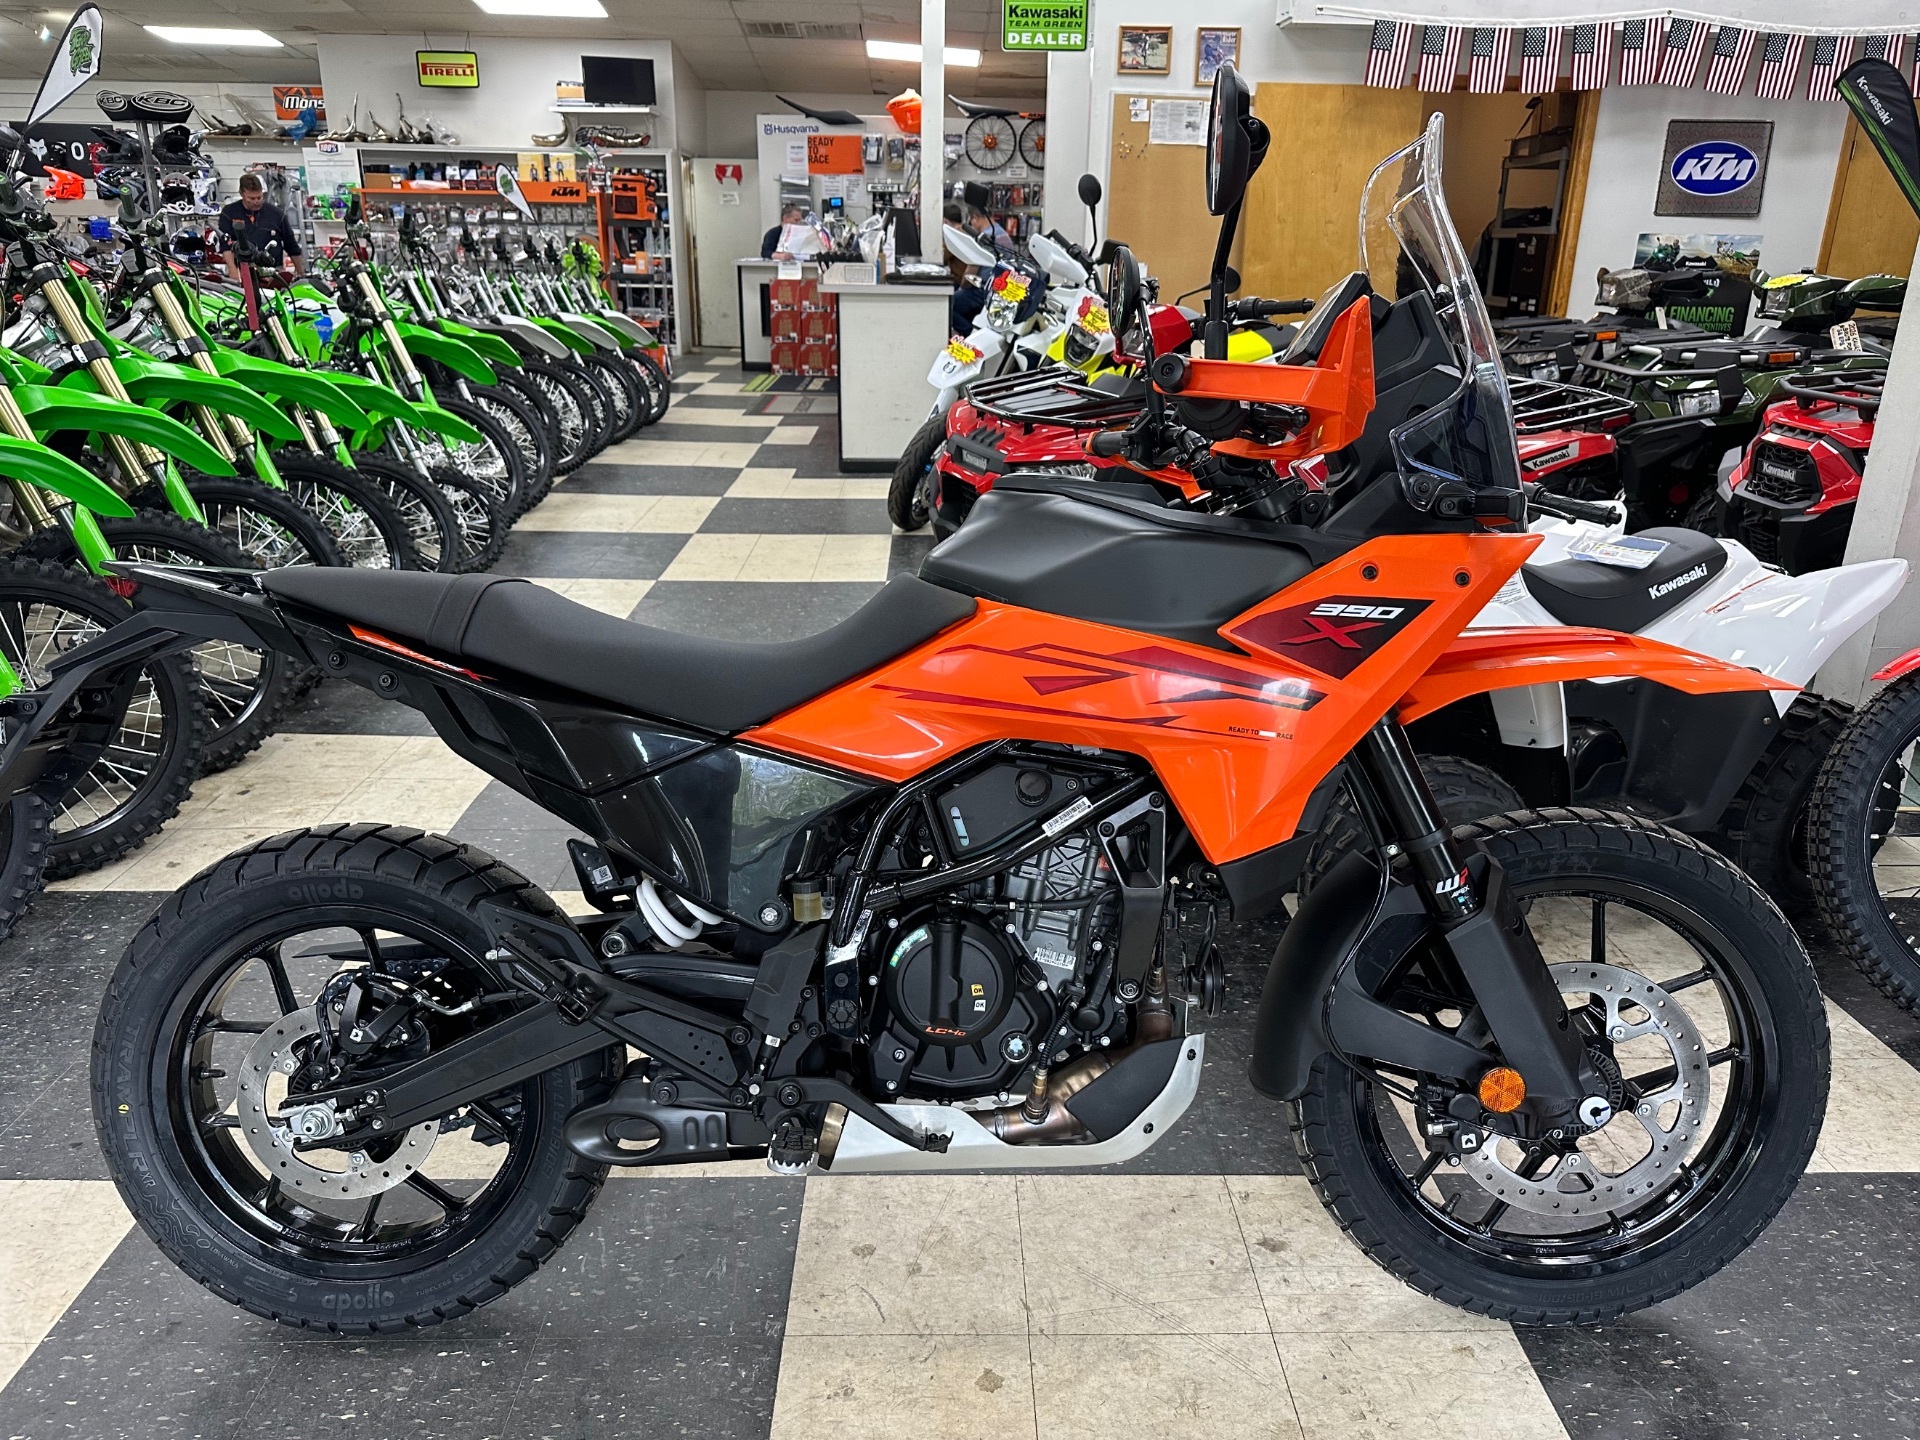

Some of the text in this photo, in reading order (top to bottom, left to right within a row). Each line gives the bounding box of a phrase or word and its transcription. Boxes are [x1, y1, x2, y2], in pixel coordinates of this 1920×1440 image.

[1009, 5, 1083, 19] Kawasaki
[1044, 20, 1083, 28] GREEN
[1008, 32, 1083, 45] DEALER
[421, 63, 475, 77] PIRELLI
[100, 96, 123, 105] KBC
[139, 96, 188, 106] KBC
[1857, 76, 1893, 125] Kawasaki
[774, 124, 819, 135] Husqvarna
[808, 137, 834, 147] READY
[808, 147, 819, 155] TO
[808, 155, 830, 164] RACE
[1675, 153, 1754, 180] KTM
[551, 187, 580, 196] KTM
[1669, 306, 1735, 323] FINANCING
[962, 449, 987, 470] Kawasaki
[1532, 450, 1571, 468] Kawasaki
[1763, 462, 1795, 480] Kawasaki
[1648, 563, 1708, 599] Kawasaki
[1309, 603, 1406, 619] 390
[1278, 617, 1387, 649] X
[1228, 726, 1250, 734] READY
[1436, 866, 1468, 894] WP
[288, 878, 363, 904] apollo
[416, 1279, 452, 1297] TUBELESS
[321, 1283, 395, 1316] apollo
